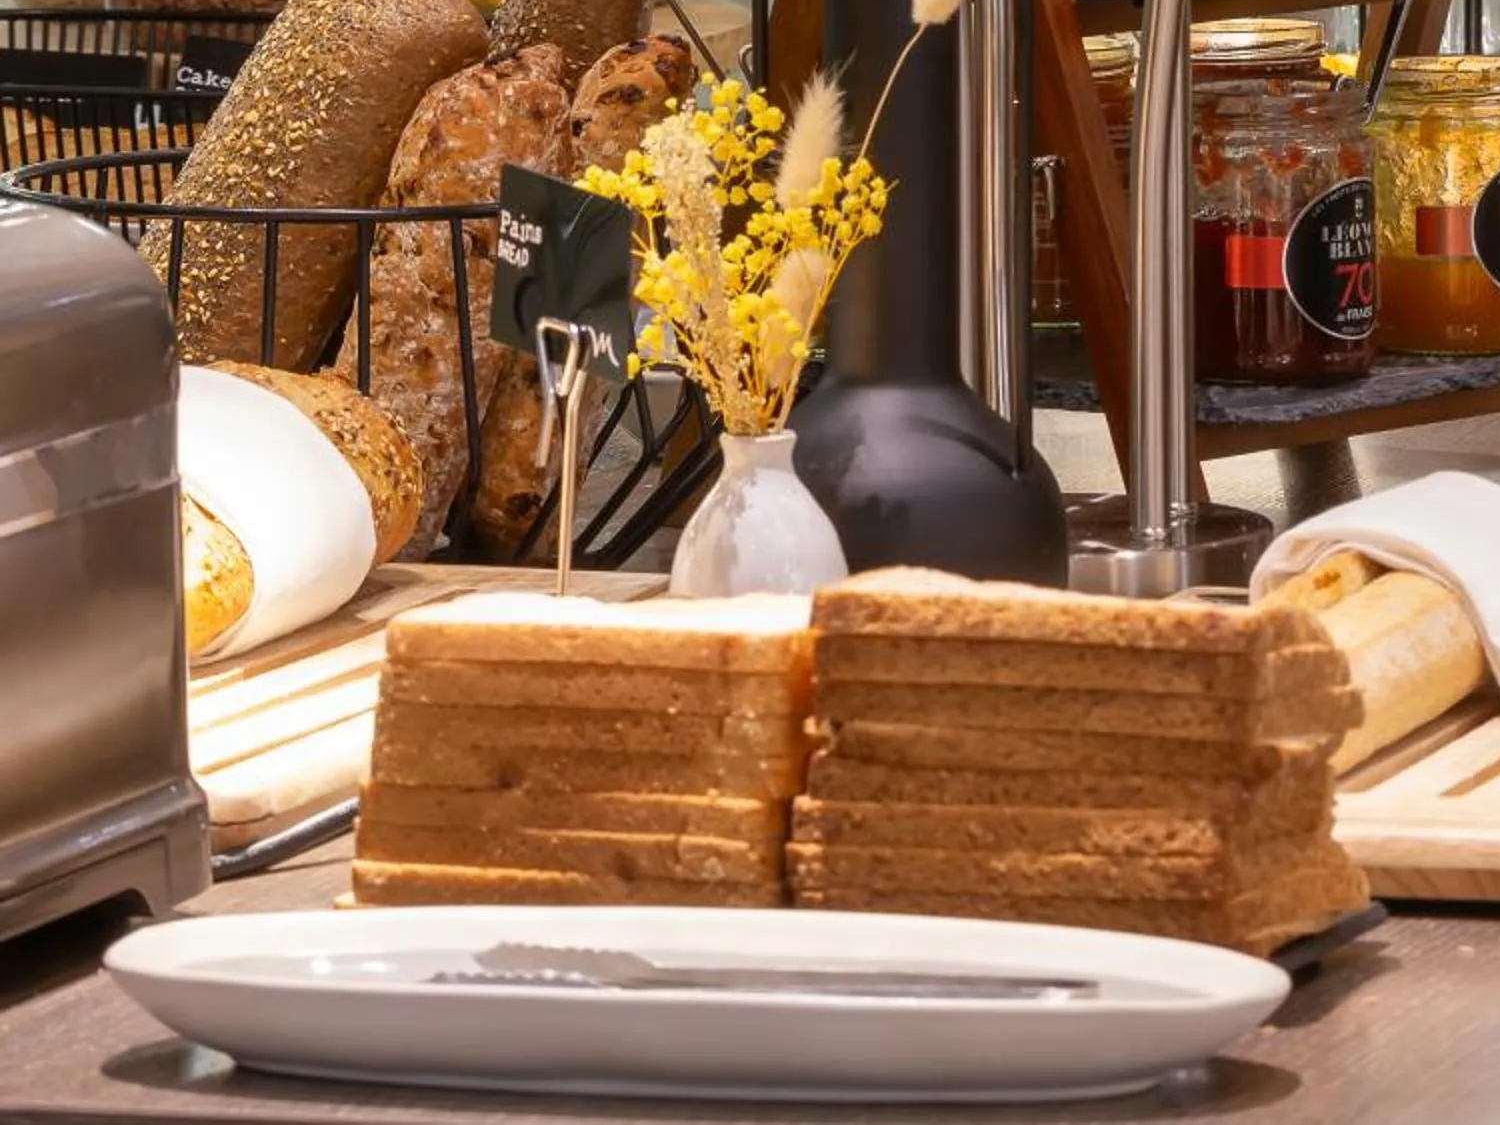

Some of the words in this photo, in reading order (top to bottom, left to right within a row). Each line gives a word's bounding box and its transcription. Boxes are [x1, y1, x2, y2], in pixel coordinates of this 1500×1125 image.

[500, 209, 543, 245] Pains
[497, 238, 530, 267] BREAD
[1336, 262, 1373, 307] 70
